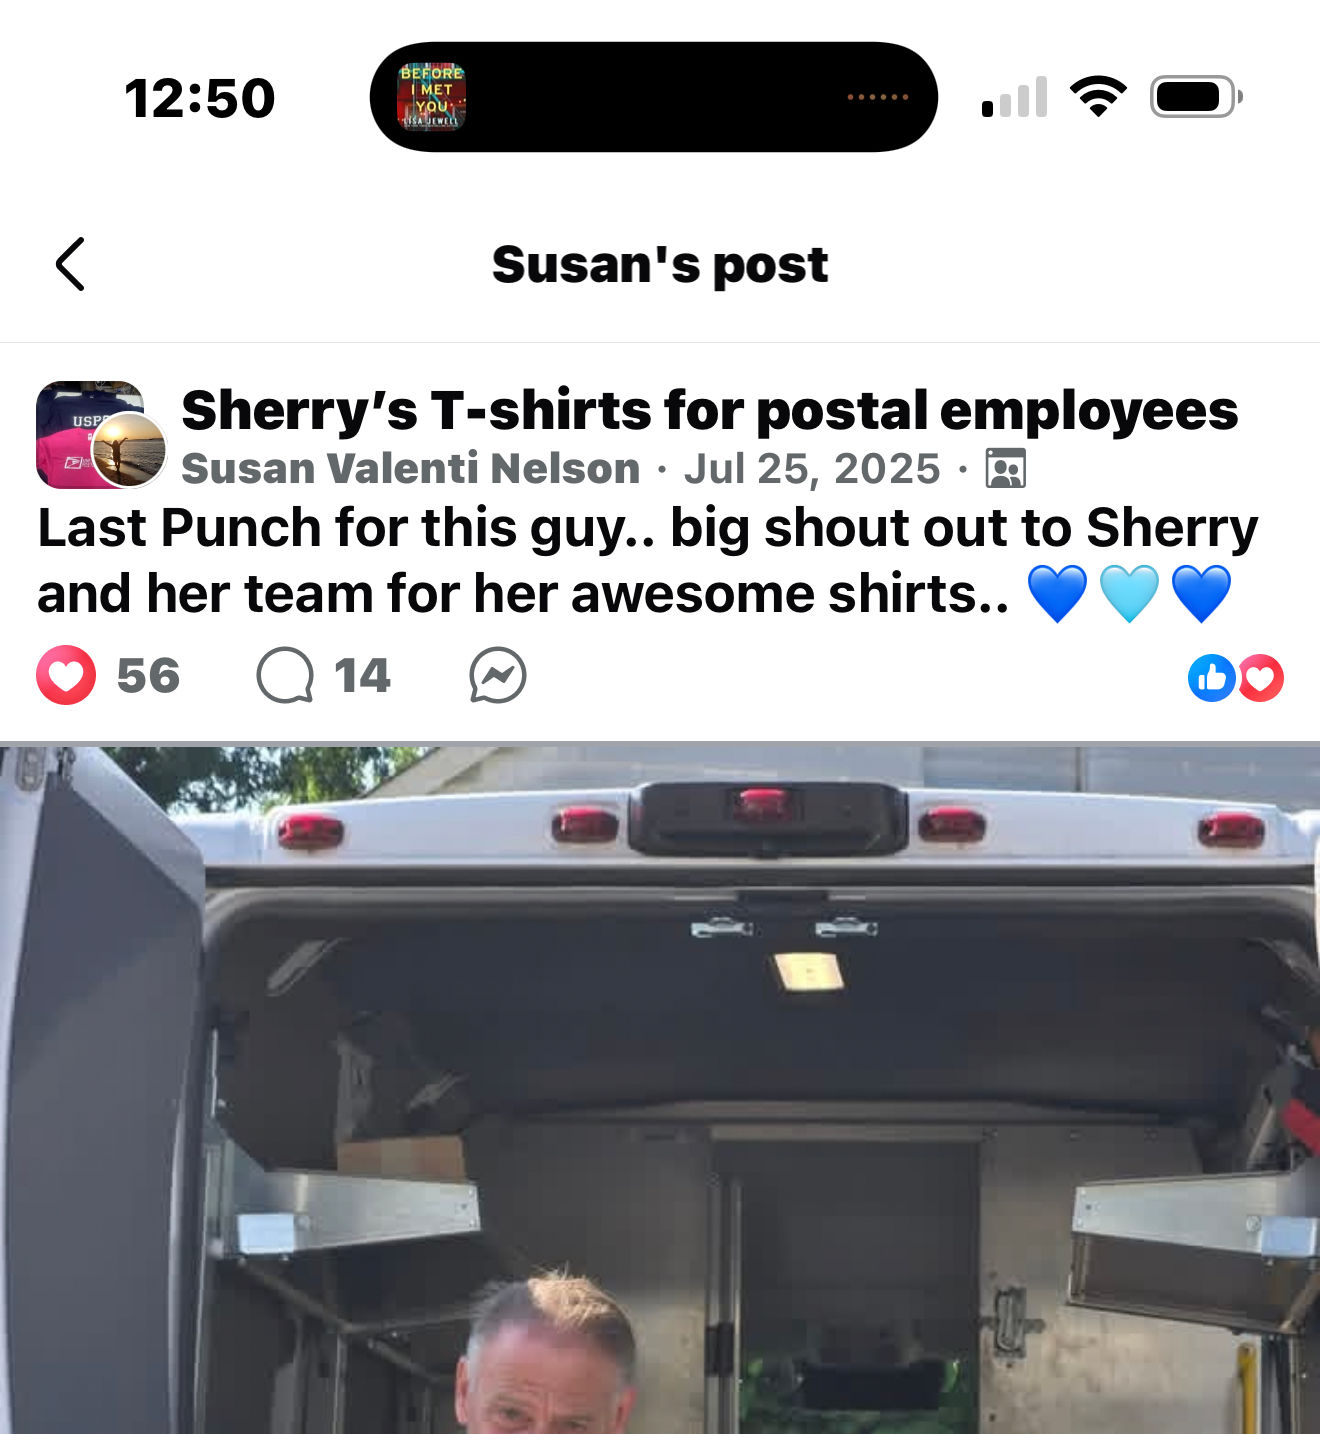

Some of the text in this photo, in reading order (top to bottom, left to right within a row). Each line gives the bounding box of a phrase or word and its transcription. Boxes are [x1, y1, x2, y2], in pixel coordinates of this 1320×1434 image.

[401, 68, 463, 79] BEFORE
[411, 84, 453, 95] I MET
[125, 77, 275, 119] 12:50
[415, 101, 448, 112] YOU
[492, 244, 829, 292] Susan's post
[182, 385, 1239, 441] Sherry’s T-shirts for postal employees
[181, 449, 941, 492] Susan Valenti Nelson Jul 25, 2025
[39, 503, 1260, 557] Last Punch for this guy.. big shout out to Sherry
[37, 569, 1008, 614] and her team for her awesome shirts..
[117, 657, 180, 694] 56
[335, 657, 391, 693] 14
